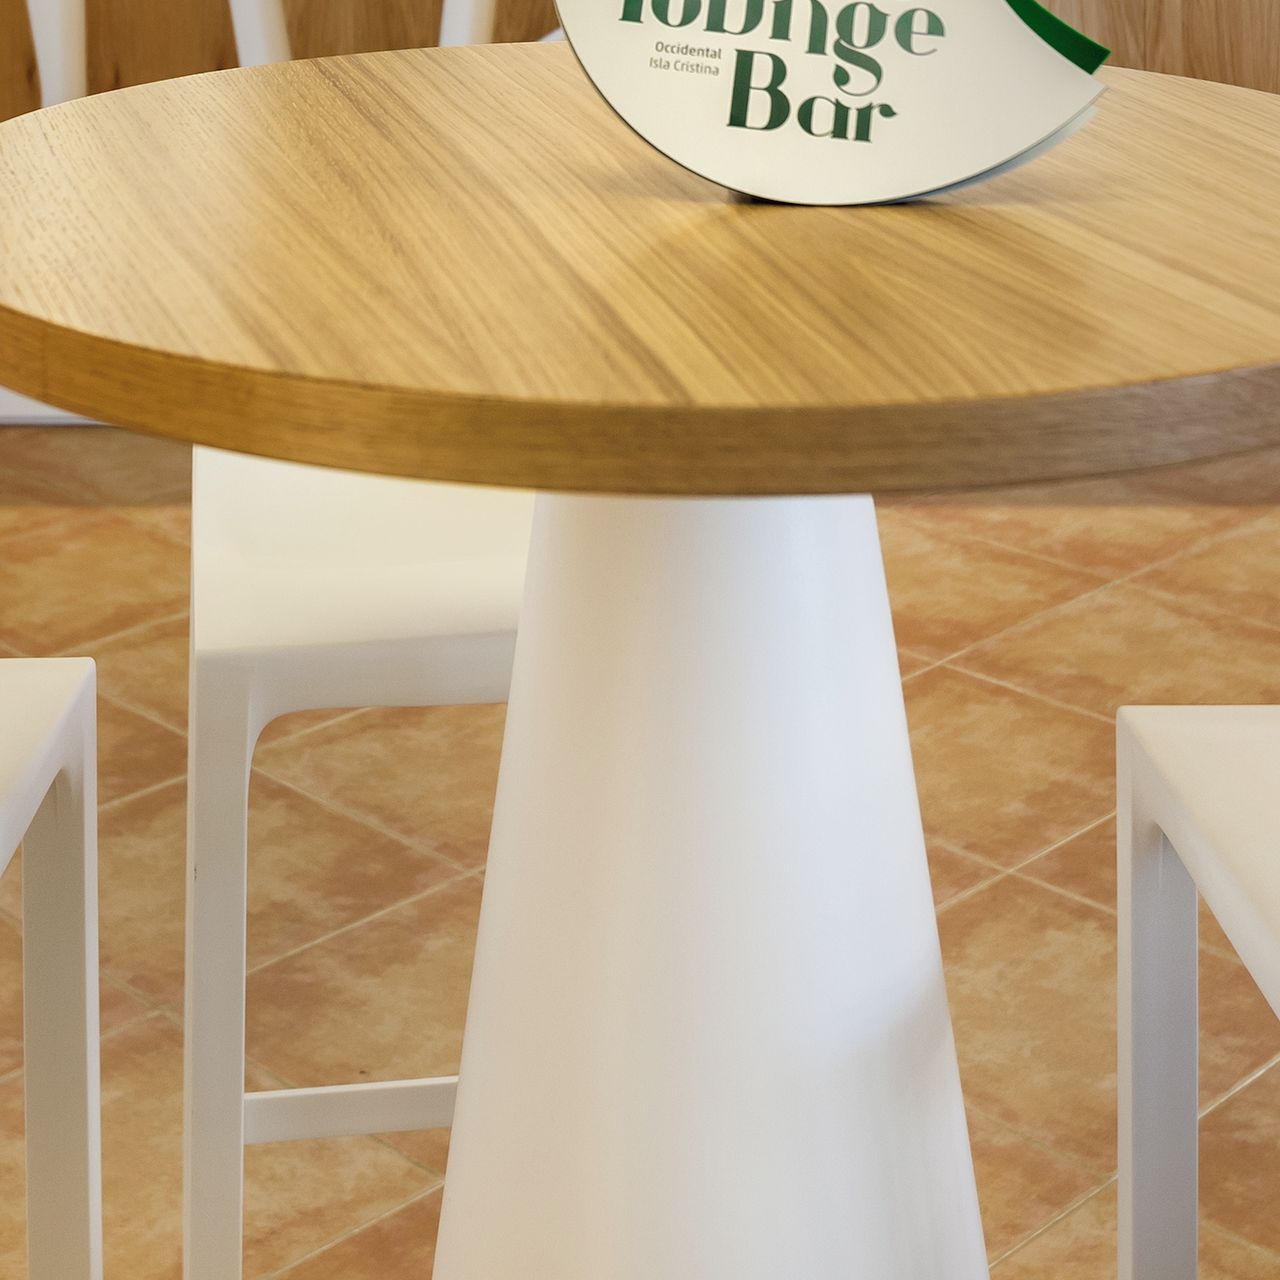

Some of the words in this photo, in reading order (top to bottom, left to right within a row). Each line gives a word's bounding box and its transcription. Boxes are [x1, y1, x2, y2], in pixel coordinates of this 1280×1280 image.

[655, 41, 722, 60] Occidental
[649, 57, 671, 70] Isla
[673, 60, 720, 76] Cristina
[726, 48, 898, 143] Bar
